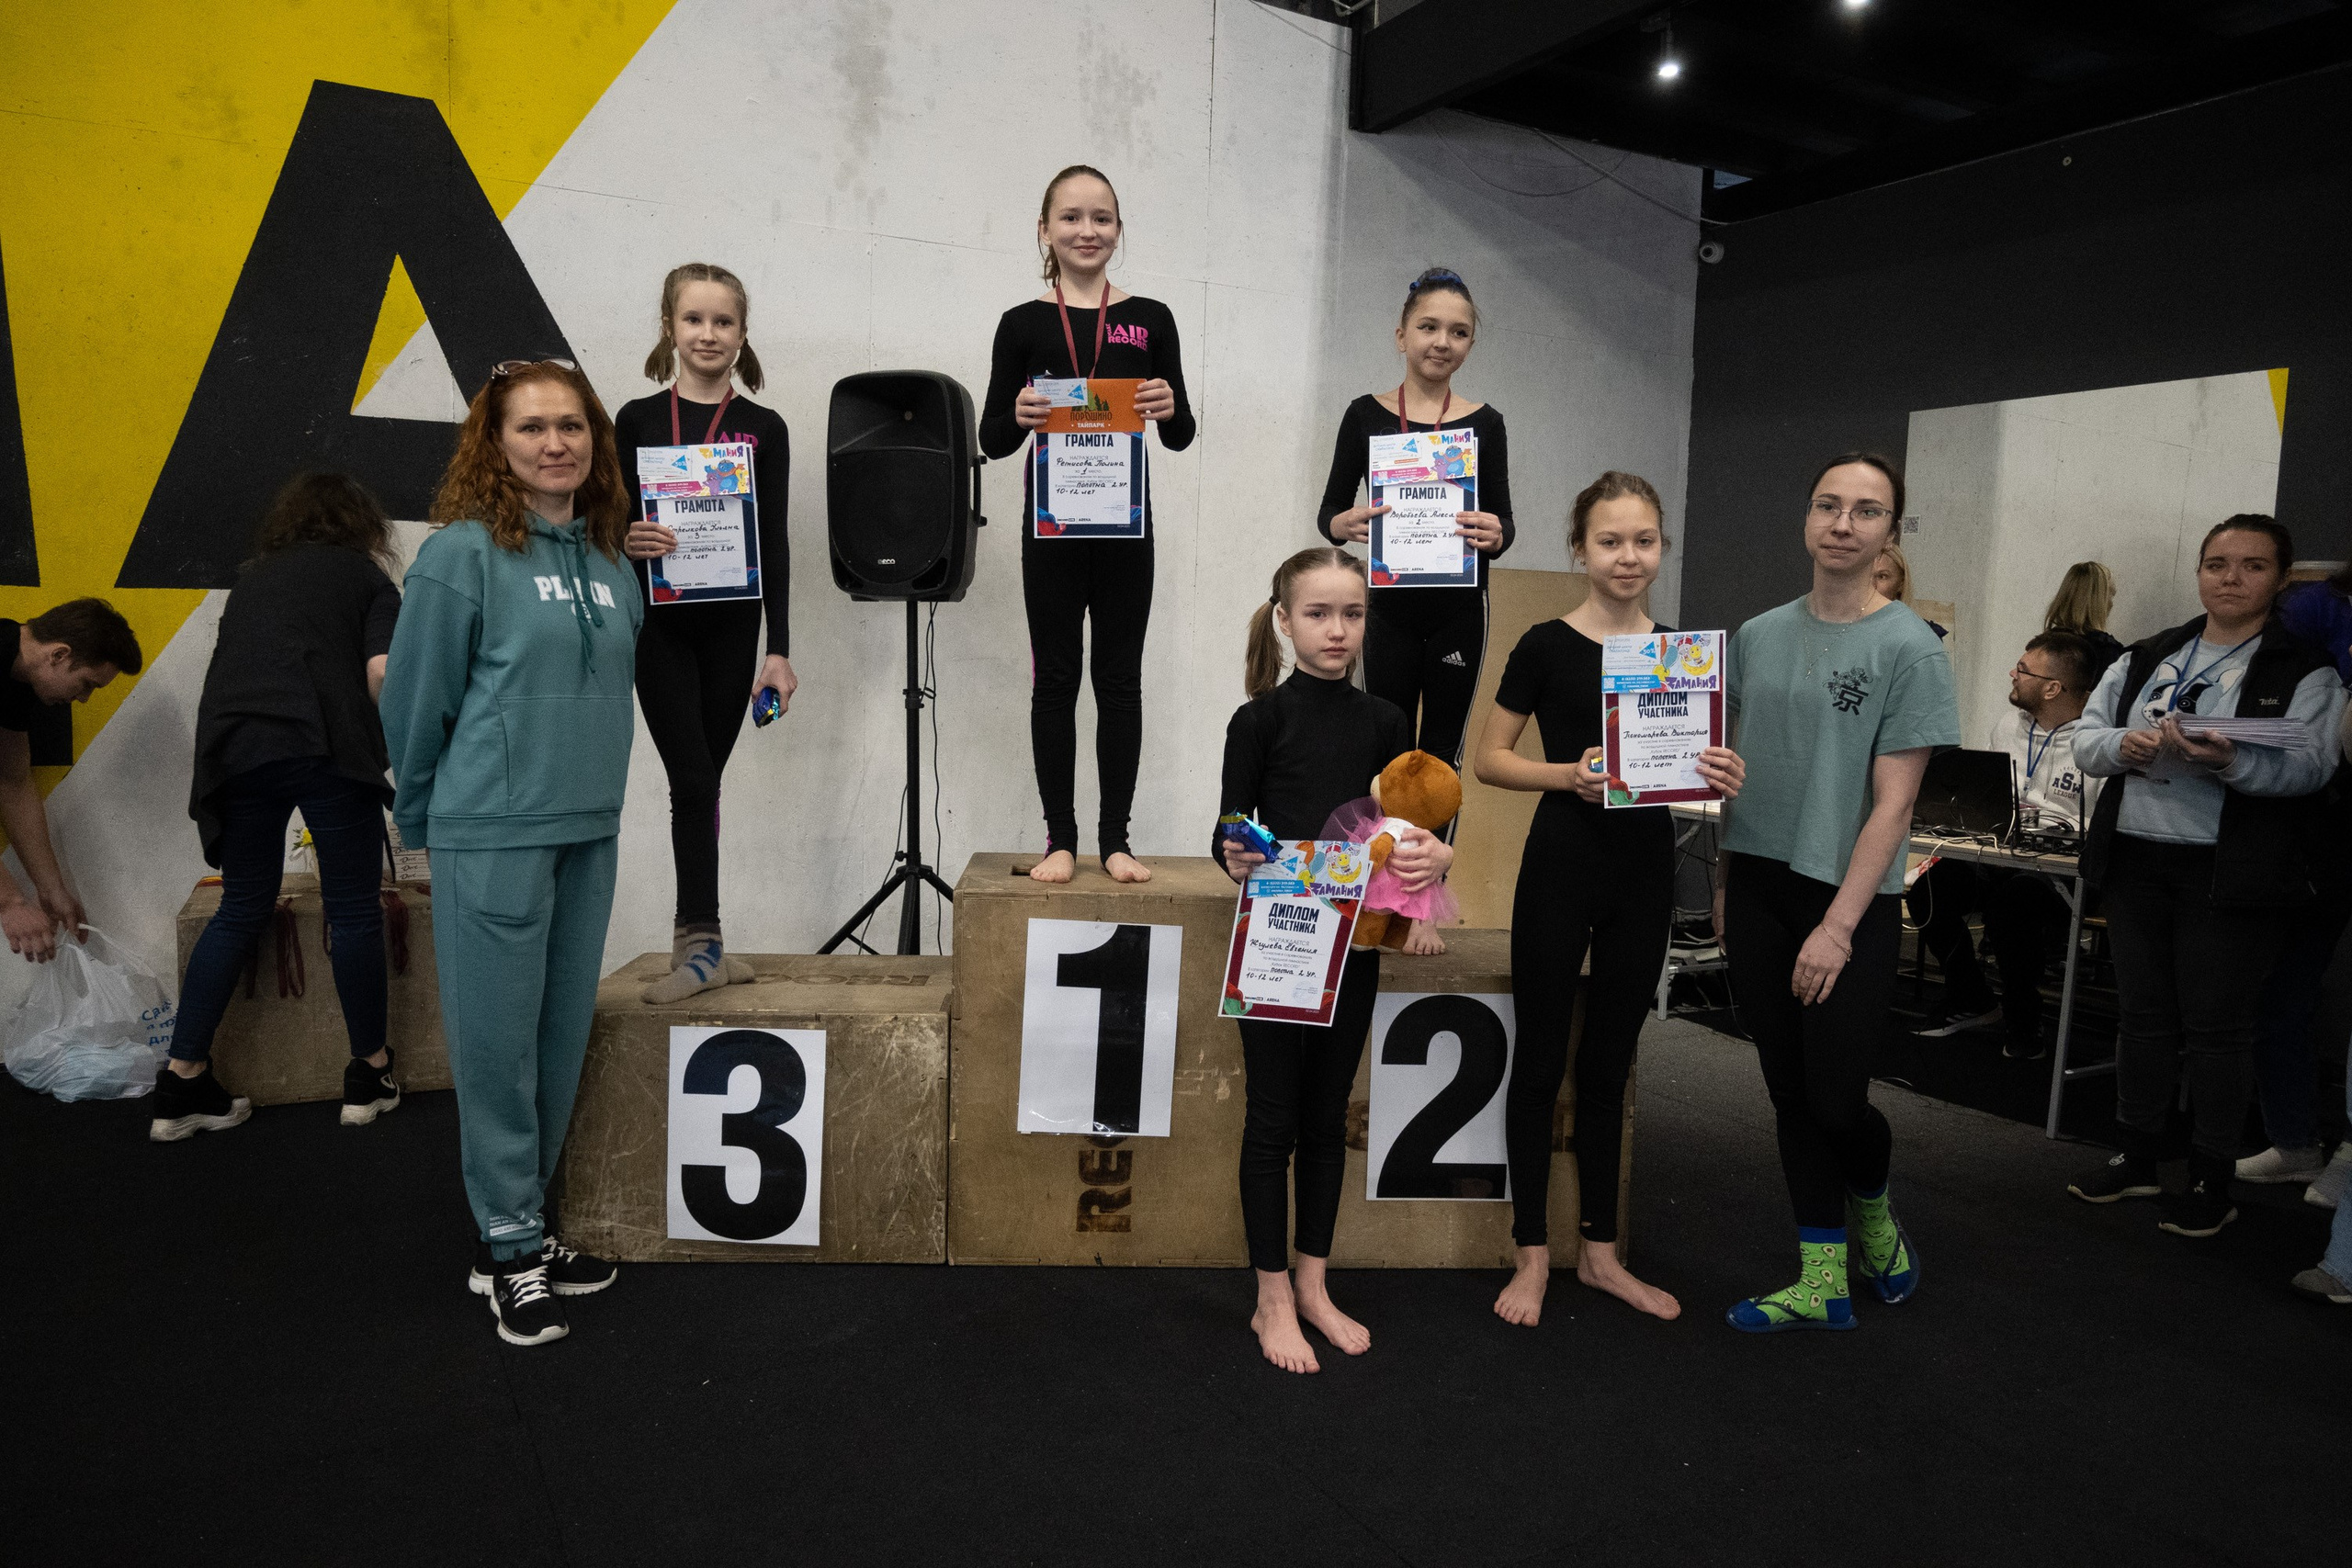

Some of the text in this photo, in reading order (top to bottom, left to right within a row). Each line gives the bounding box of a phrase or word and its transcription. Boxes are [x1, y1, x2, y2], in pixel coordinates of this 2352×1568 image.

[1070, 410, 1113, 421] ПОРОШИНО
[1065, 434, 1114, 447] ГРАМОТА
[1399, 487, 1447, 500] ГРАМОТА
[674, 499, 726, 513] ГРАМОТА
[1442, 657, 1466, 667] adidas
[1637, 691, 1688, 707] ДИПЛОМ
[1638, 705, 1689, 719] УЧАСТНИКА
[2053, 789, 2077, 800] LEAGUE
[1268, 902, 1320, 923] ДИПЛОМ
[1268, 918, 1317, 935] УЧАСТНИКА
[1057, 923, 1152, 1134] 1
[1375, 994, 1509, 1200] 2
[681, 1029, 808, 1241] 3
